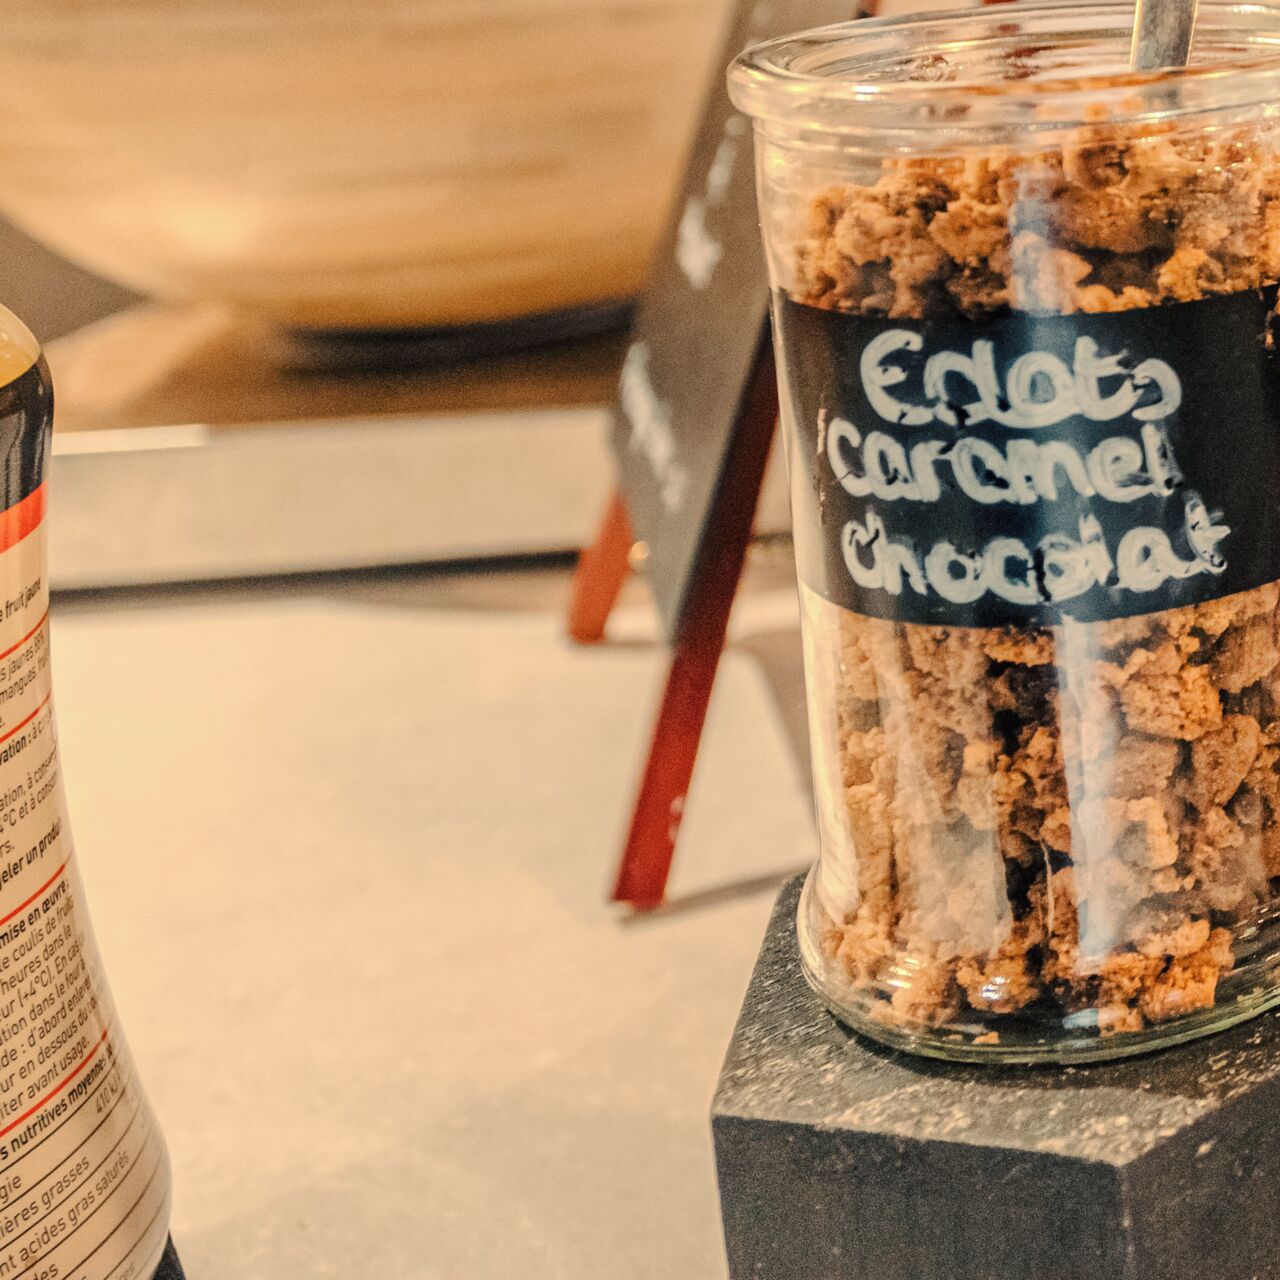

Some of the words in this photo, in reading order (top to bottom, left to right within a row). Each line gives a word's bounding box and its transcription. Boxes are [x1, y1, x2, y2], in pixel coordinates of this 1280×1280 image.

[827, 417, 1178, 504] Caramel
[26, 846, 38, 865] un
[12, 927, 45, 962] coulis
[45, 917, 57, 935] de
[28, 907, 41, 926] en
[0, 955, 42, 996] heures
[43, 934, 65, 961] dans
[55, 955, 67, 975] En
[29, 992, 56, 1021] dans
[55, 982, 65, 998] le
[19, 1058, 36, 1079] en
[37, 1019, 78, 1065] dessous
[27, 1062, 60, 1099] avant
[10, 1098, 68, 1153] nutritives
[41, 1156, 90, 1210] grasses
[19, 1216, 67, 1262] acides
[67, 1190, 95, 1228] gras
